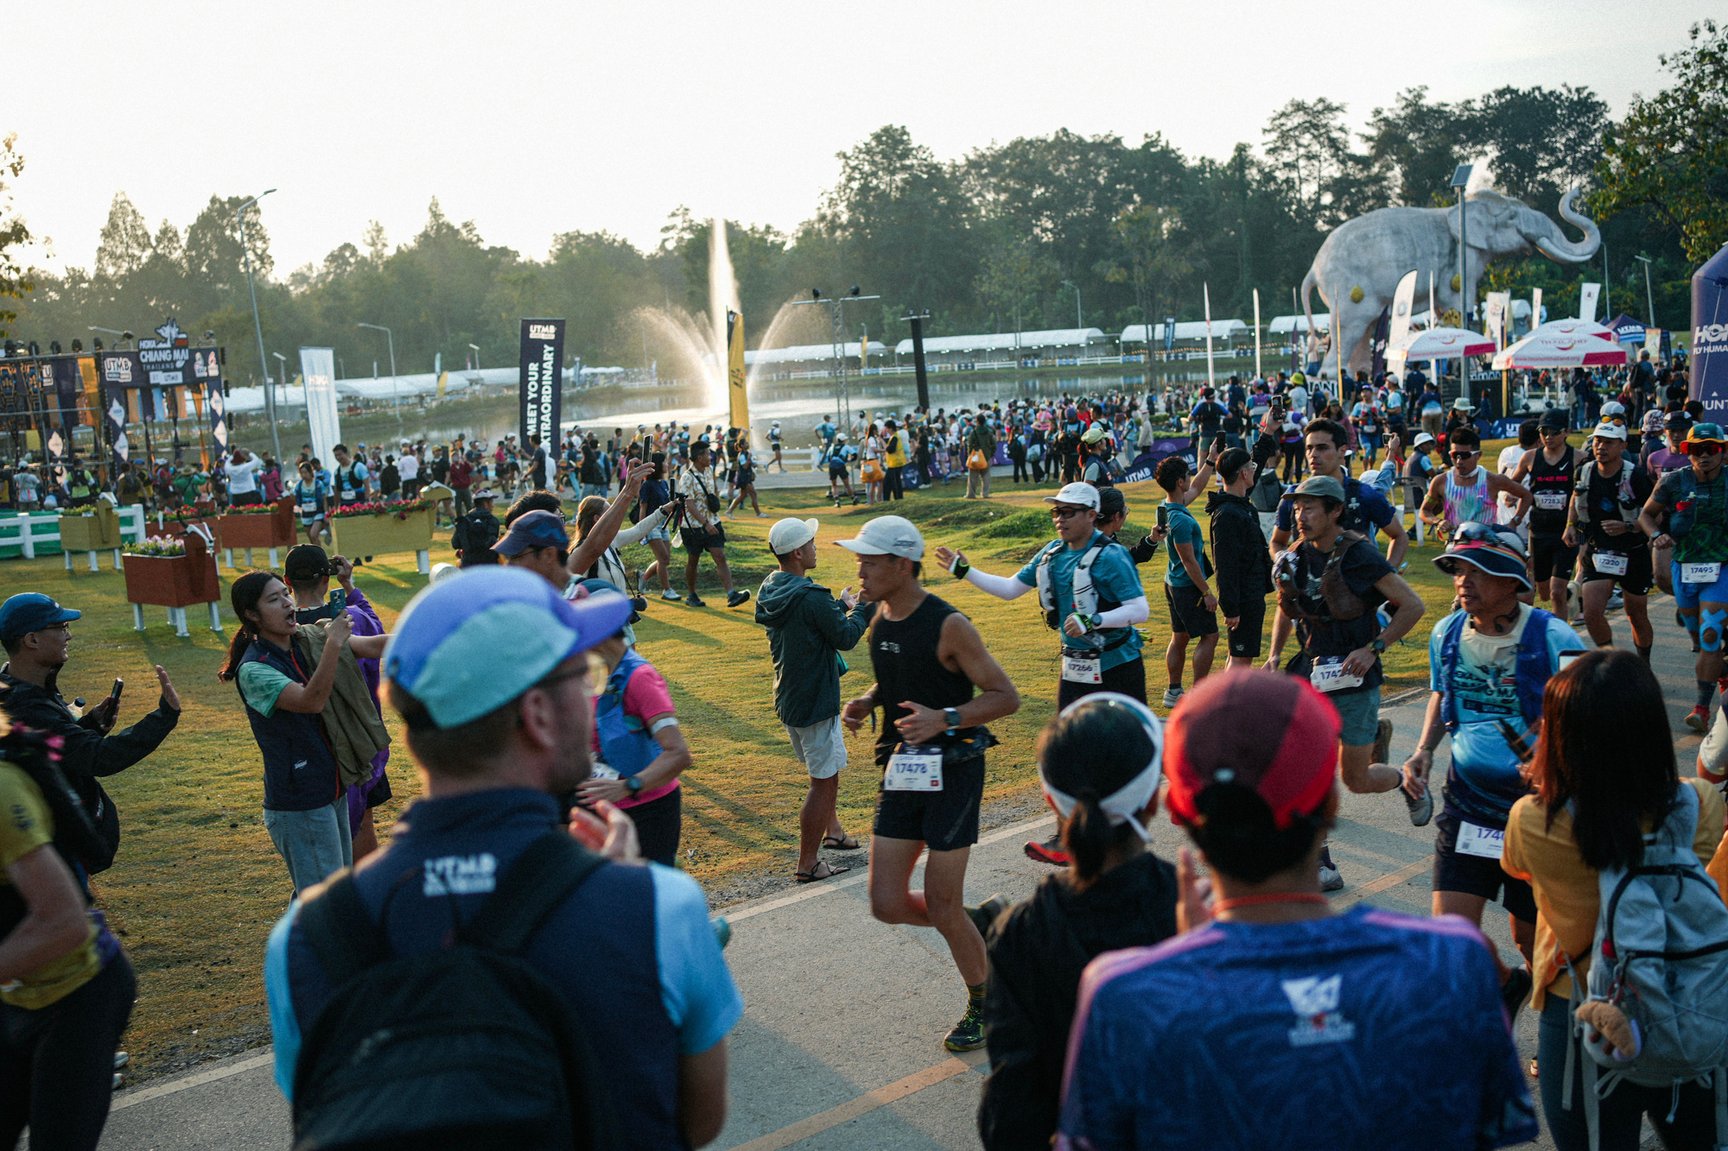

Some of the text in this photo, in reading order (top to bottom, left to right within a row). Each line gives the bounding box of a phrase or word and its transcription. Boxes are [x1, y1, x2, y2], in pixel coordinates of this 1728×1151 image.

[530, 324, 555, 334] UTMB
[140, 348, 189, 362] CHIANG MAI
[1703, 344, 1728, 354] HUMA
[105, 358, 131, 371] UTMB
[526, 362, 539, 436] MEET YOUR
[1125, 467, 1152, 483] UTMB
